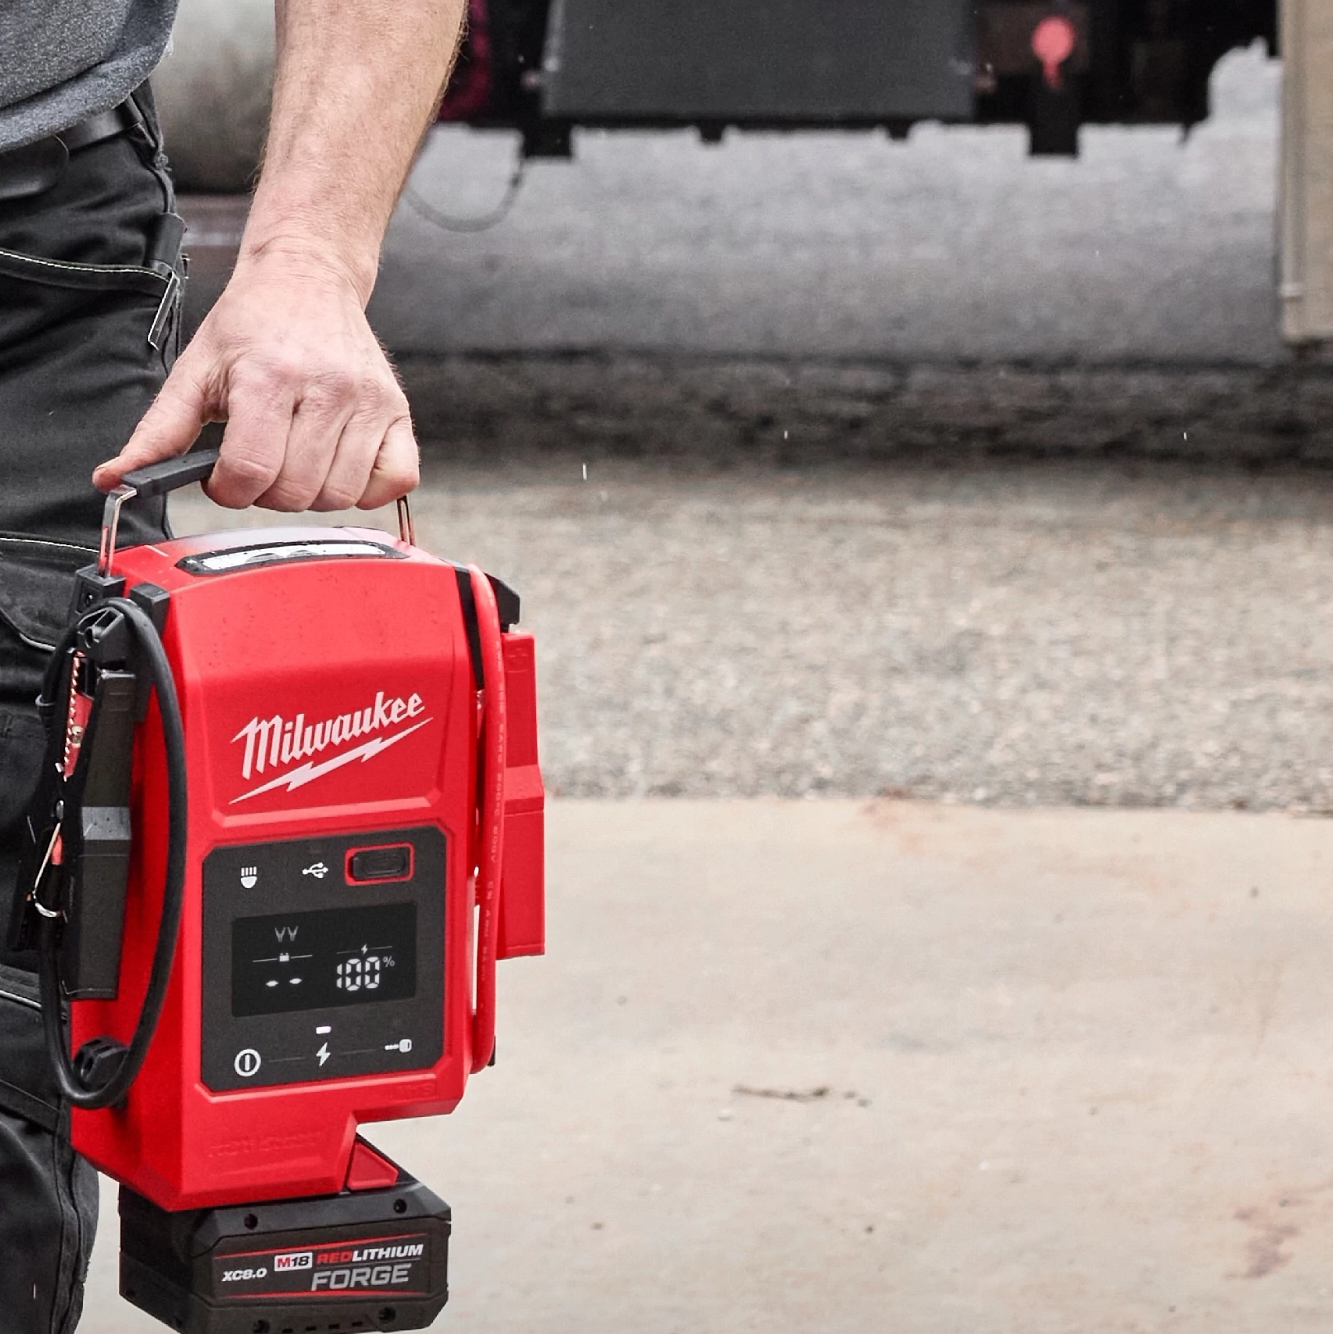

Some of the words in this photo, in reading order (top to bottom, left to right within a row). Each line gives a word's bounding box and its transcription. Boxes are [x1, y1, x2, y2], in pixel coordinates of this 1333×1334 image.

[229, 690, 426, 780] Milwaukee
[276, 1254, 312, 1270] M18
[316, 1244, 424, 1265] REDLITHIUM
[311, 1263, 413, 1291] FORGE
